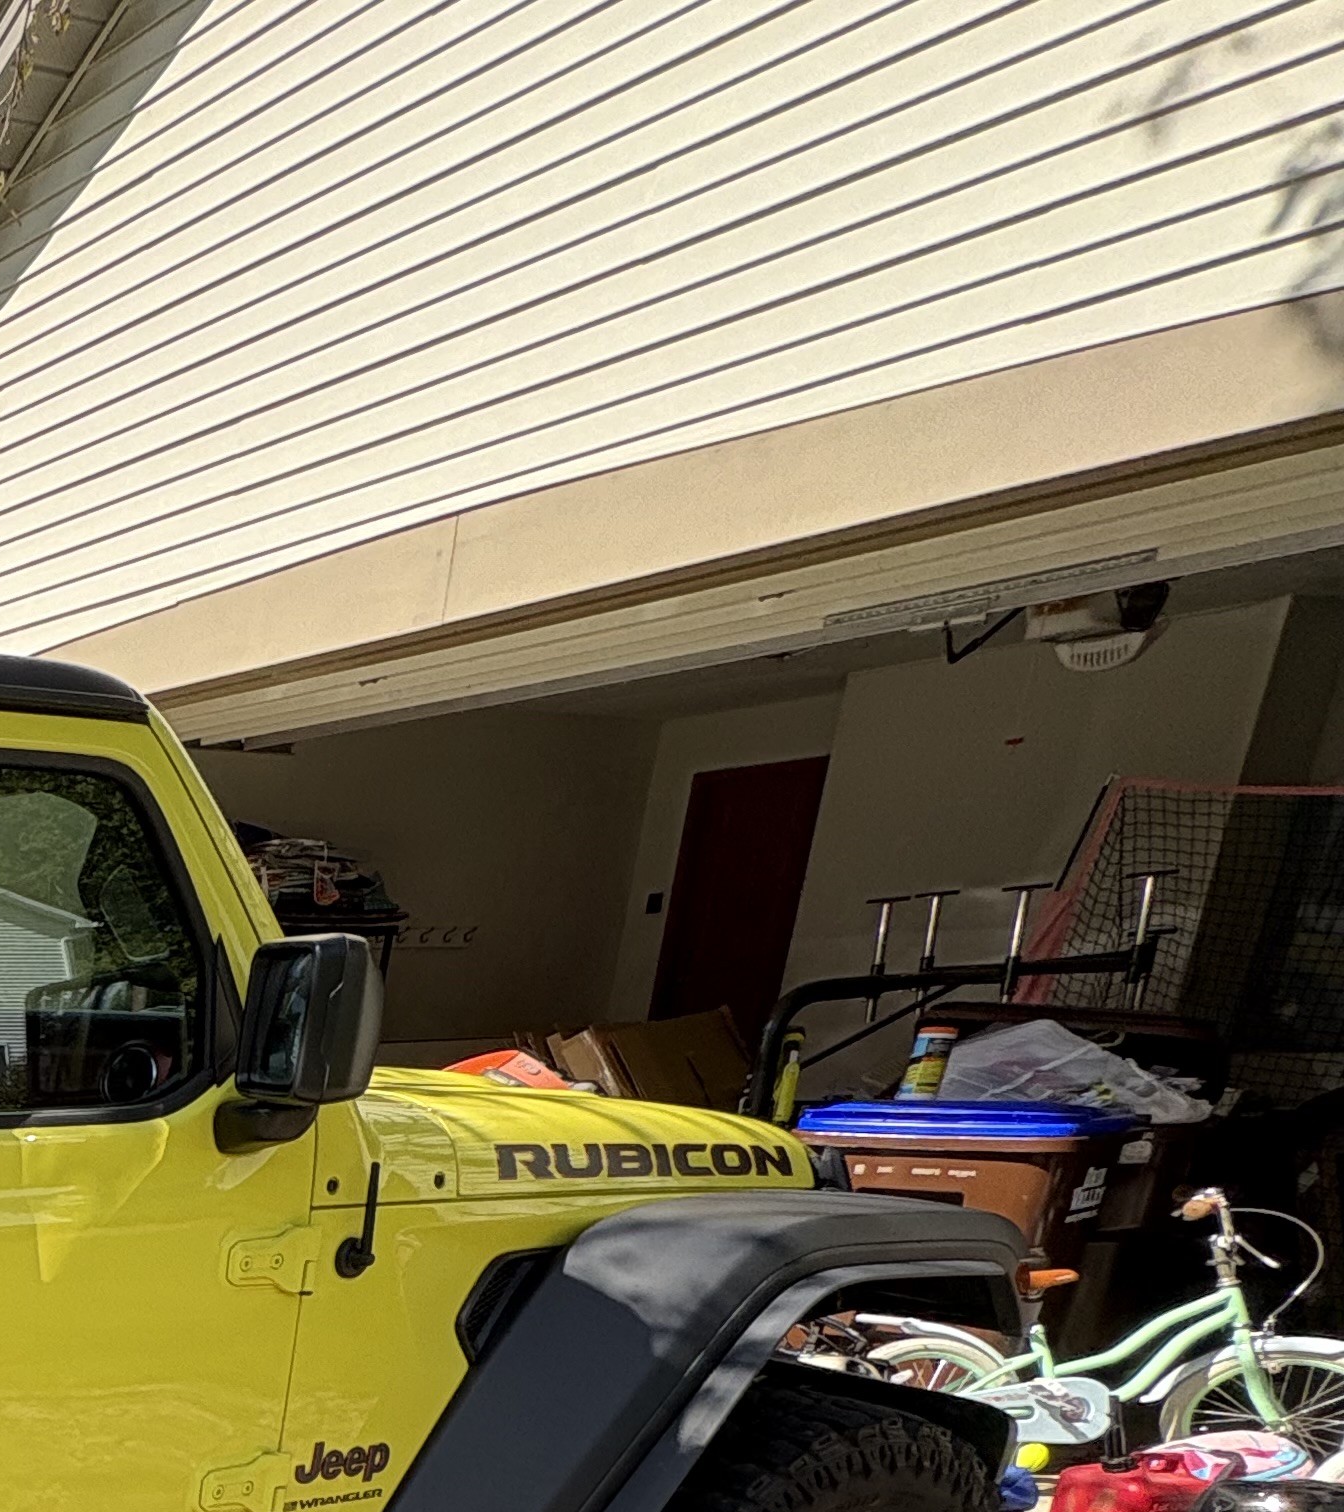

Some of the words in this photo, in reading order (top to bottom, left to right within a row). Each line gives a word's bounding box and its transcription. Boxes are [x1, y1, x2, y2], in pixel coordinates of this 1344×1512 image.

[495, 1142, 794, 1180] RUBICON
[295, 1441, 390, 1484] Jeep
[298, 1488, 383, 1510] WRANGLER
